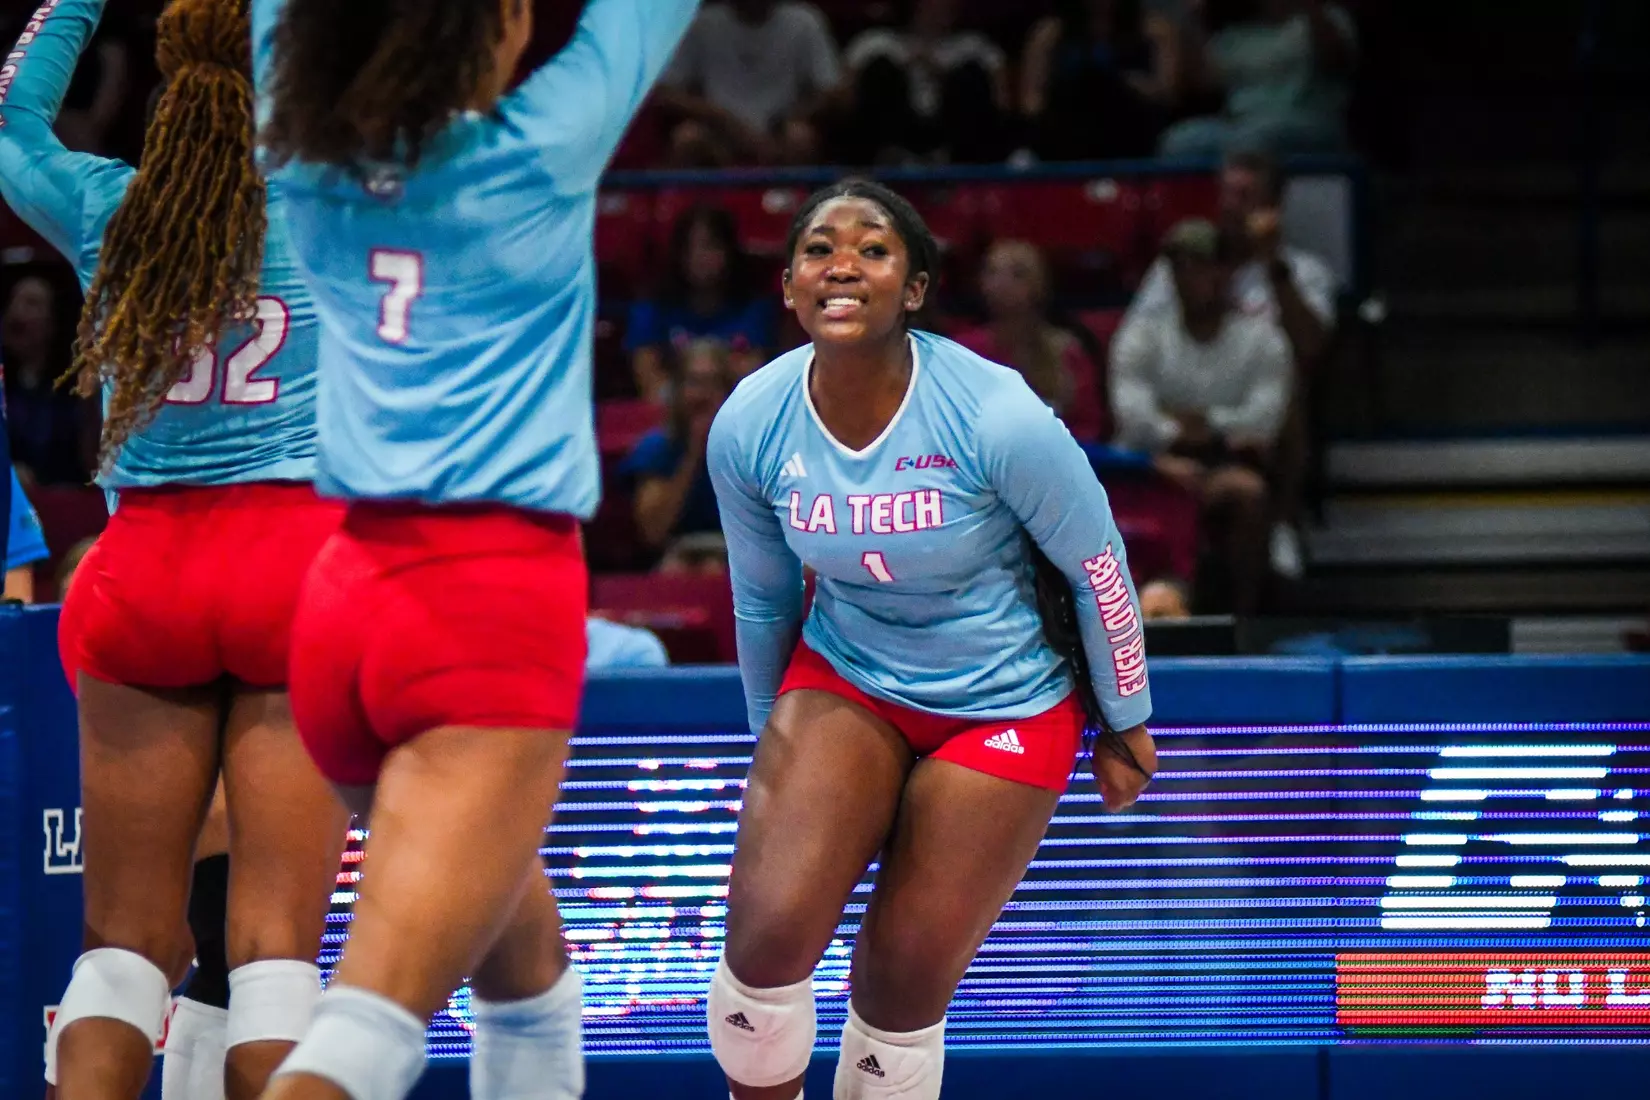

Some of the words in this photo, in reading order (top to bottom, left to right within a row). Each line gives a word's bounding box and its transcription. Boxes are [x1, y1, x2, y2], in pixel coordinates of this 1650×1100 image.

[368, 246, 423, 344] 7
[789, 491, 837, 535] LA
[847, 488, 943, 535] TECH
[861, 551, 895, 582] 1
[1112, 632, 1147, 698] EVER
[984, 738, 1025, 755] adidas
[724, 1015, 756, 1033] adidas
[856, 1060, 886, 1079] adidas
